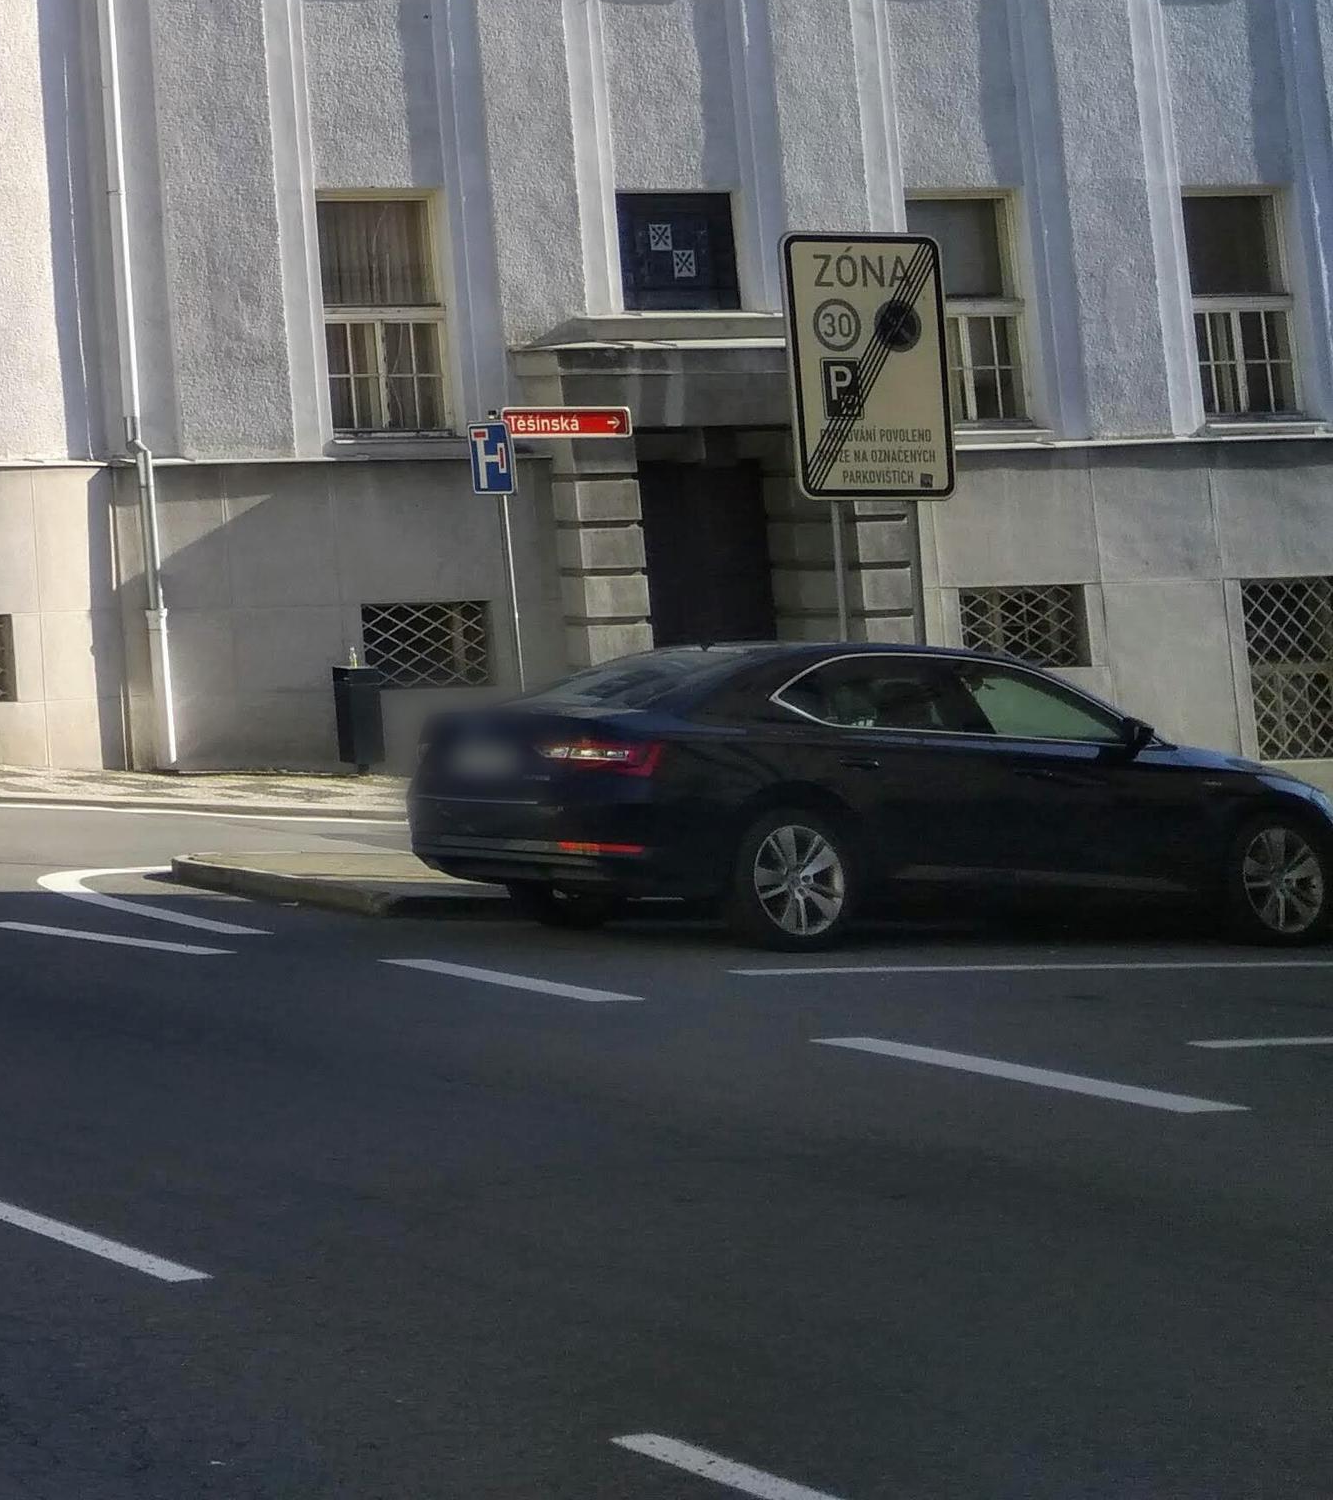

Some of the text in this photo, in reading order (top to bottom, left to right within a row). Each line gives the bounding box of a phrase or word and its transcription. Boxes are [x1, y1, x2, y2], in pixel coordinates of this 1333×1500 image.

[813, 246, 912, 288] ZÓNA
[821, 312, 852, 338] 30
[829, 365, 853, 401] P
[507, 414, 580, 432] Těšínská
[880, 428, 932, 443] POVOLENO
[854, 450, 869, 463] NA
[871, 446, 936, 464] OZNAČENÝCH
[842, 467, 914, 484] PARKOVIŠTÍCH
